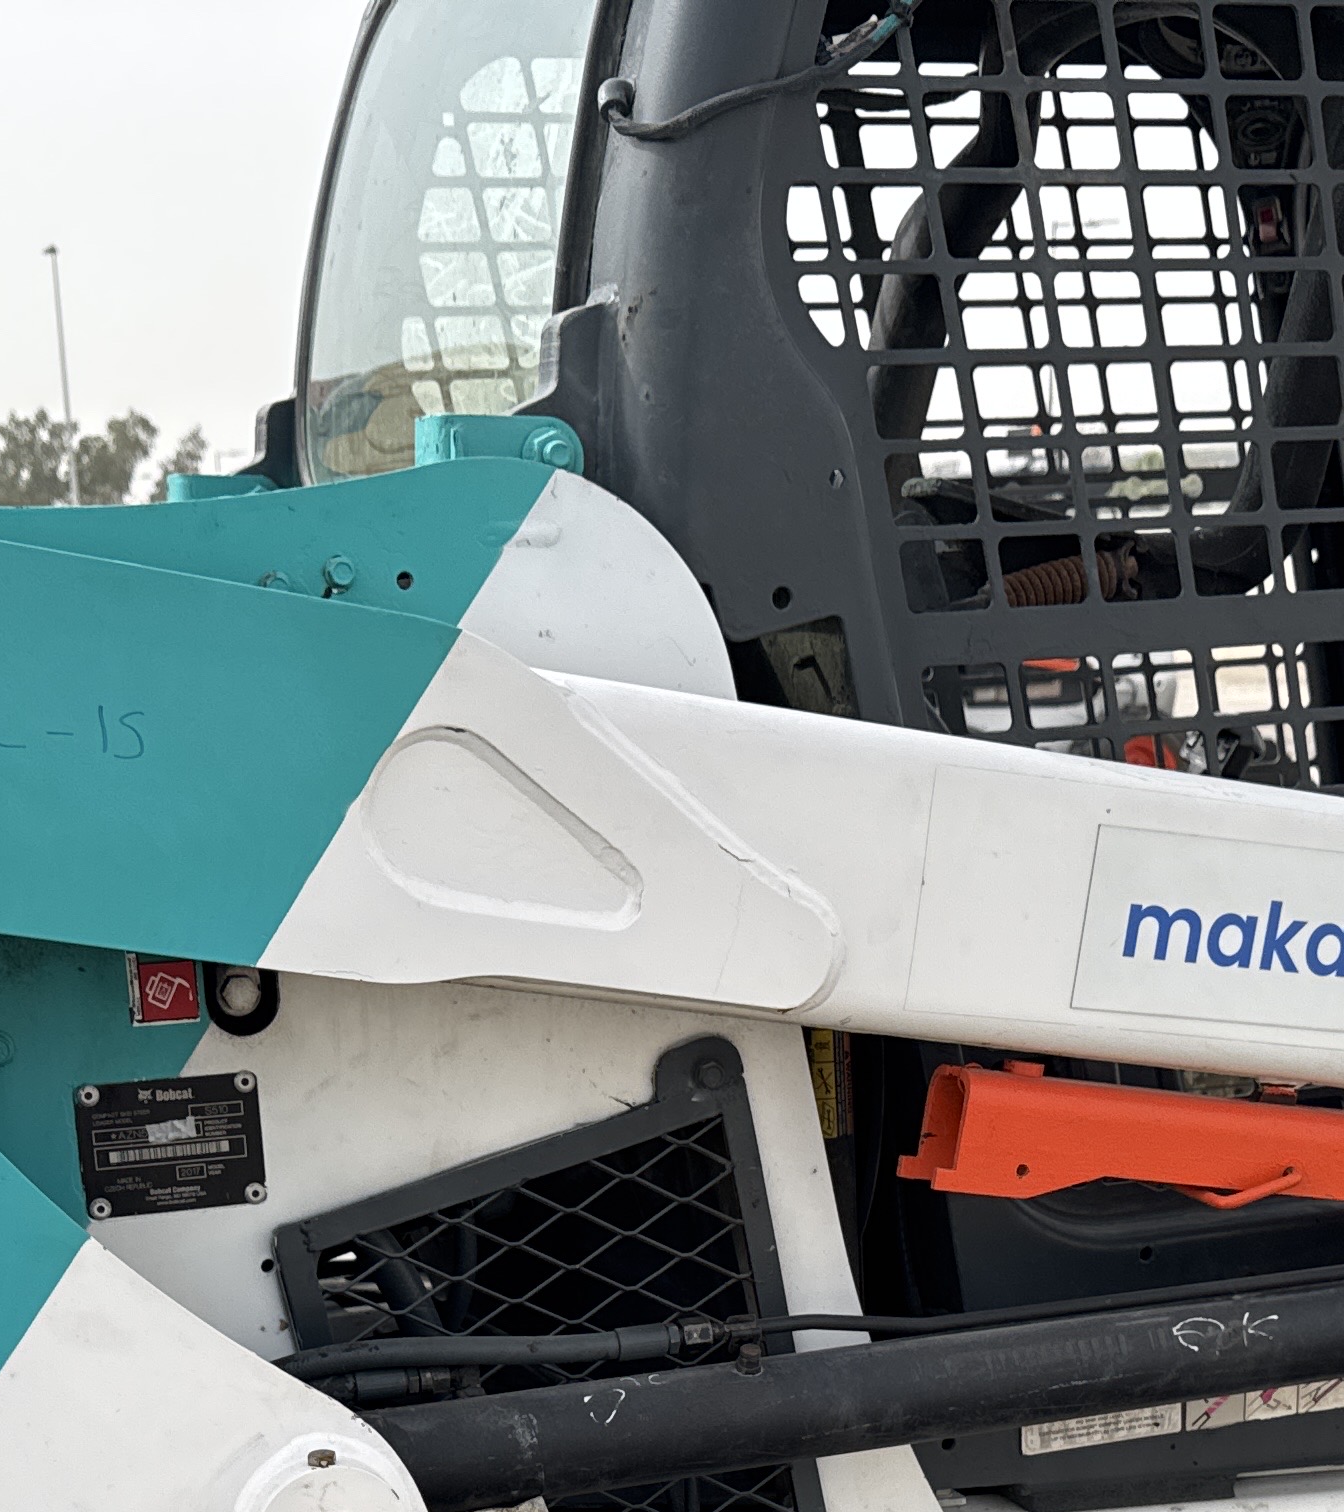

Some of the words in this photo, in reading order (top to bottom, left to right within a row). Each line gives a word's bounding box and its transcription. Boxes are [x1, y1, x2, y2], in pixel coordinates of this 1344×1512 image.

[156, 1088, 193, 1101] Bobcat
[204, 1105, 229, 1116] S510
[181, 1166, 202, 1177] 2017
